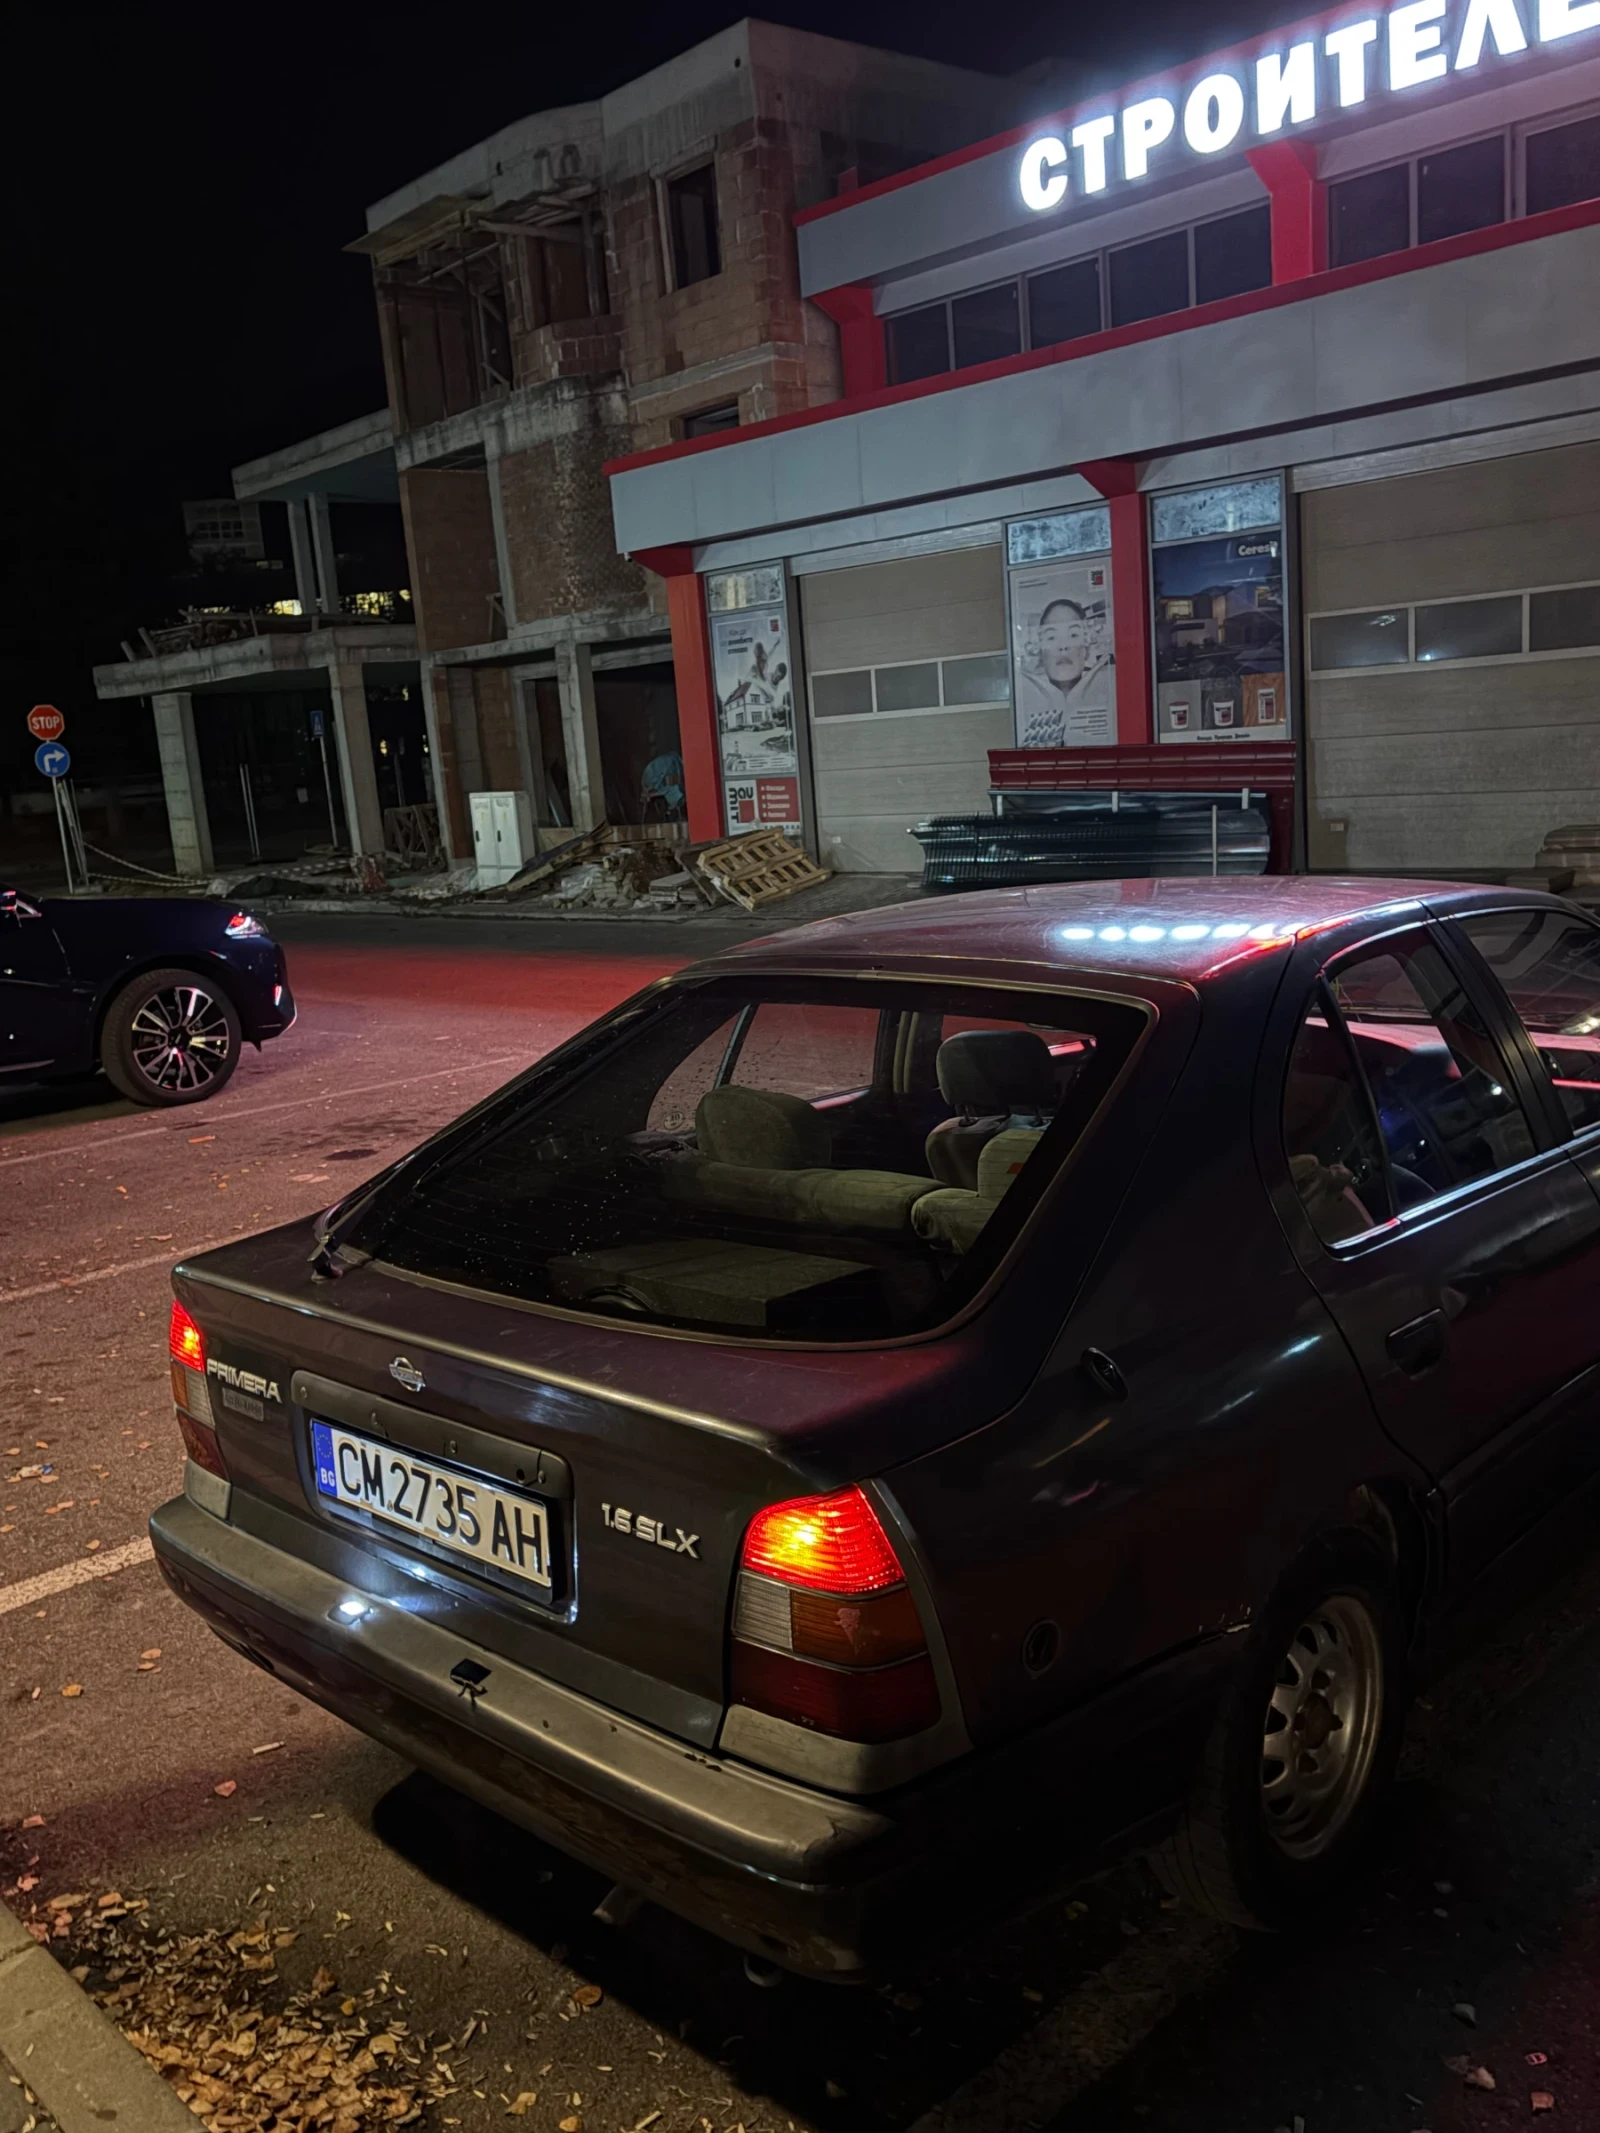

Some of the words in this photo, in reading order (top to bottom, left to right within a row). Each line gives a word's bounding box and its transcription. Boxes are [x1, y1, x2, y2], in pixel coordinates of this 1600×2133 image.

[32, 716, 60, 730] STOP
[206, 1357, 283, 1404] PRIMERA
[321, 1467, 336, 1487] BG
[636, 1515, 700, 1559] SLX
